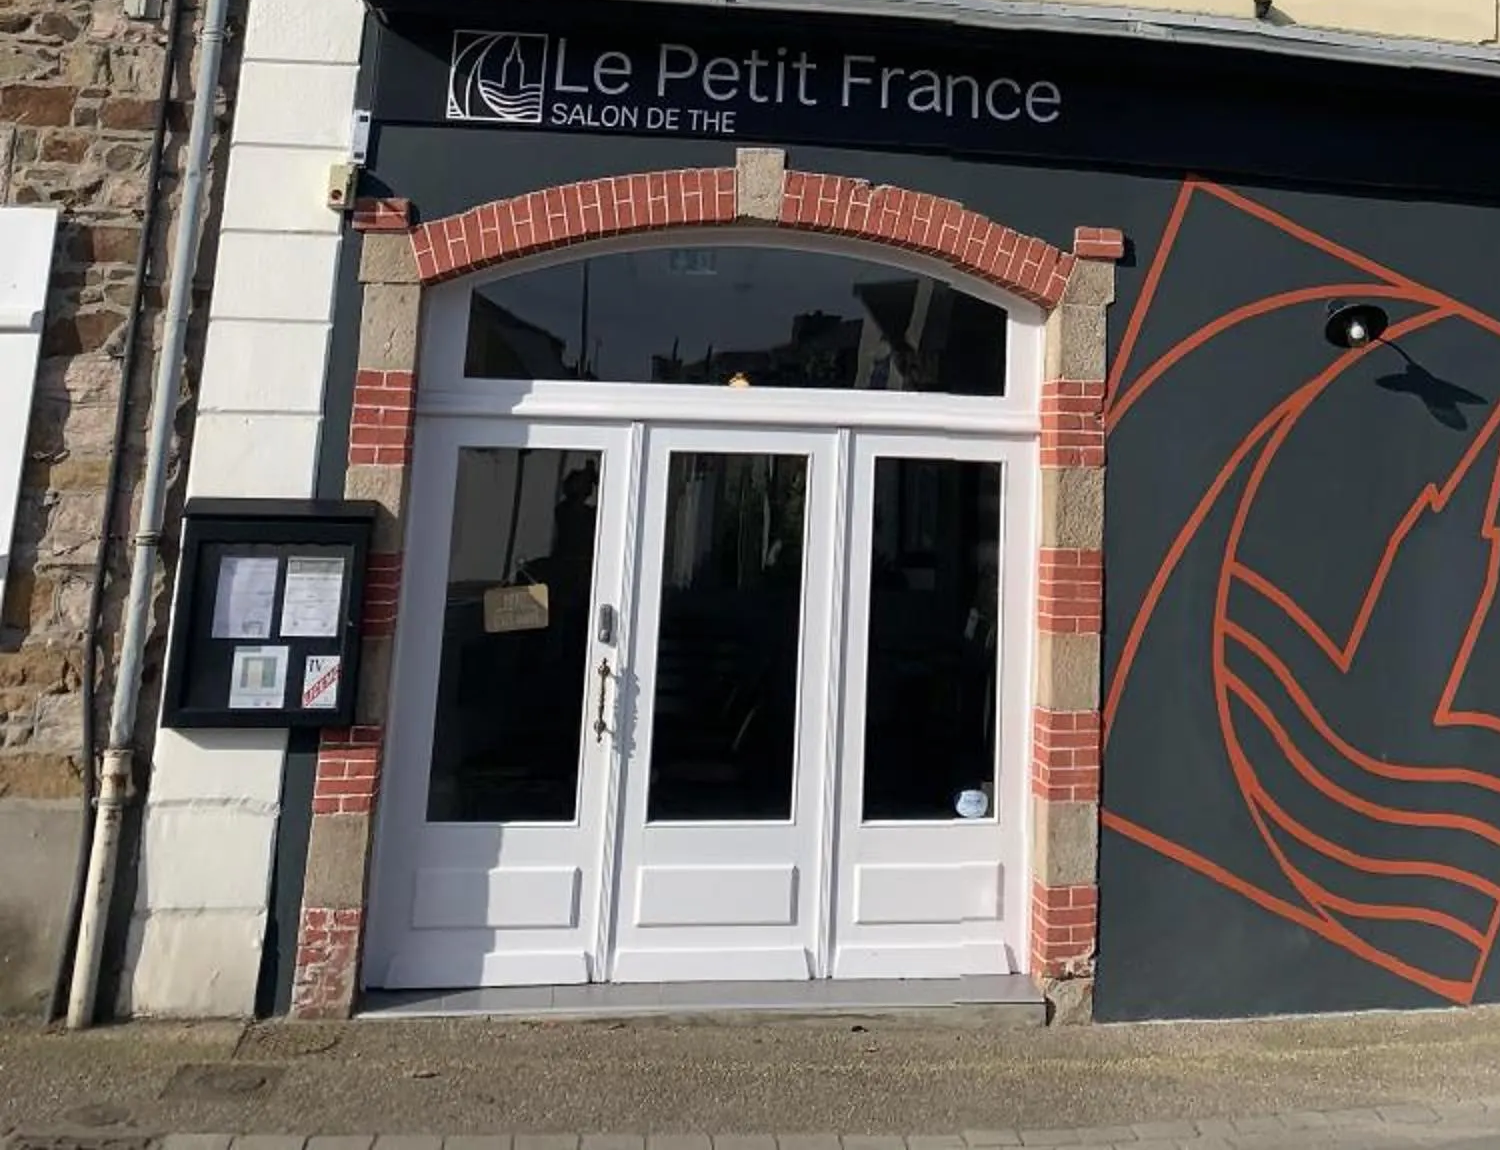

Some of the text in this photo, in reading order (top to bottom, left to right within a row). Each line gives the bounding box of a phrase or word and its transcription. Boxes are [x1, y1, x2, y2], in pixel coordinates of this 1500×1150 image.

[554, 37, 1061, 123] Le Petit France
[550, 102, 737, 133] SALON DE THE
